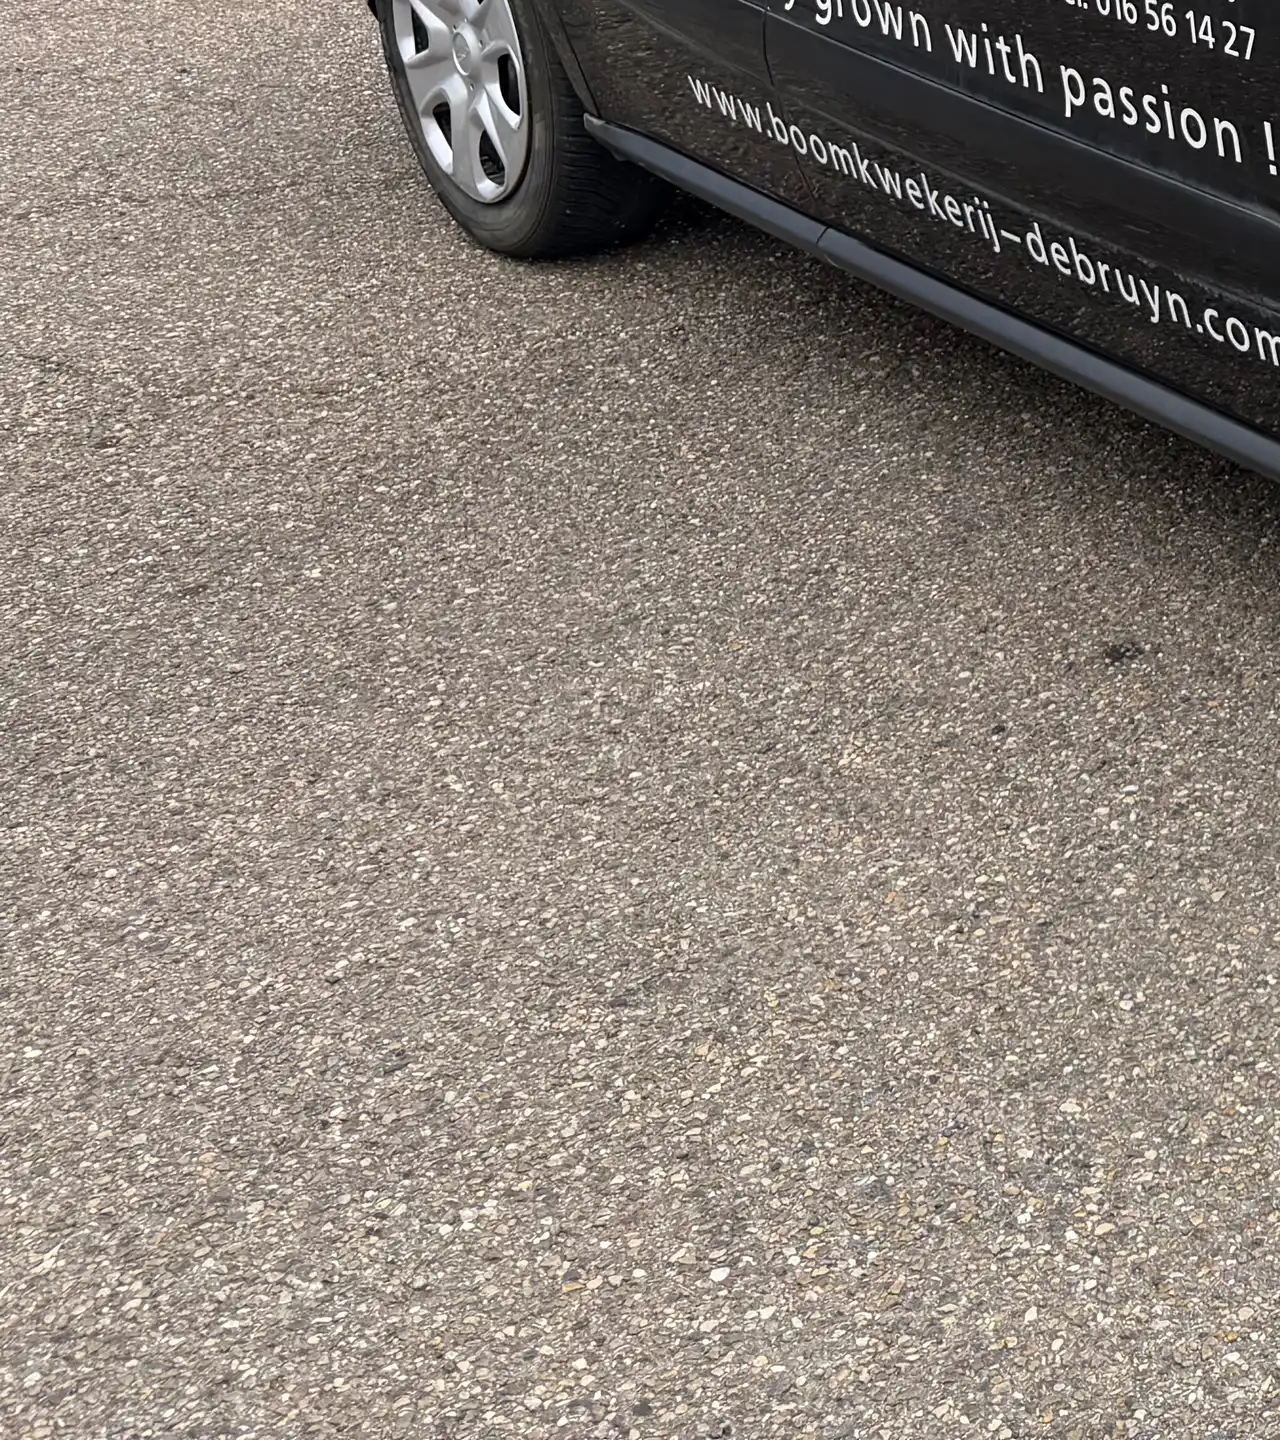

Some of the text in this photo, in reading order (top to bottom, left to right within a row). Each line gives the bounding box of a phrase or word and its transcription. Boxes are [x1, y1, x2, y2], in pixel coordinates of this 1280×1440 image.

[1185, 10, 1216, 49] 14
[1222, 20, 1255, 60] 27
[944, 23, 1044, 93] with
[1059, 65, 1242, 163] passion
[1263, 121, 1278, 176] !
